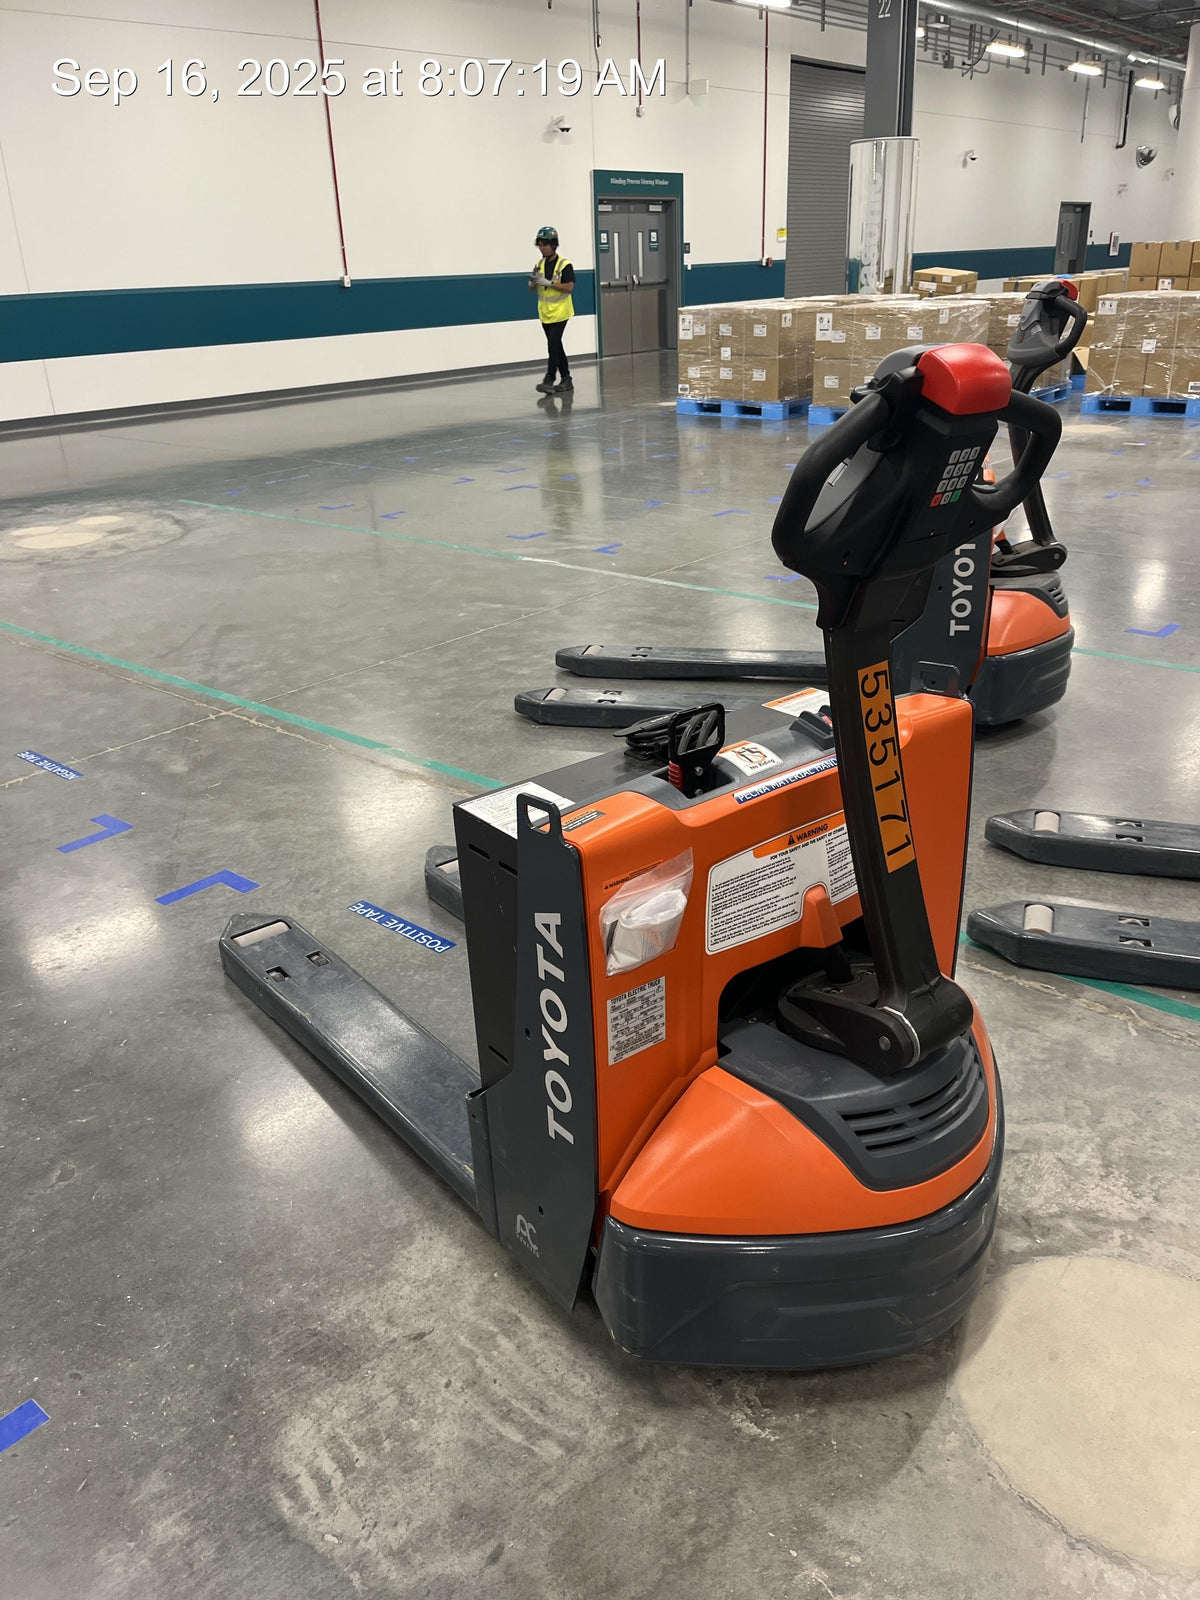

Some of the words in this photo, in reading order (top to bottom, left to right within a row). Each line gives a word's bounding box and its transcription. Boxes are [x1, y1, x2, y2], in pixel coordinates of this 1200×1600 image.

[877, 0, 891, 19] 22
[949, 543, 977, 637] TOYOT
[772, 767, 816, 789] MATERIAL
[815, 757, 839, 773] HAND
[860, 669, 912, 857] 5351771
[796, 823, 829, 842] WARNING
[608, 876, 630, 888] WARNING
[348, 902, 385, 923] TAPE
[382, 918, 450, 953] POSITIVE
[610, 994, 627, 1006] TOYOTA
[627, 984, 648, 998] ELECTRIC
[647, 978, 661, 990] TRUCK
[534, 912, 574, 1145] TOYOTA
